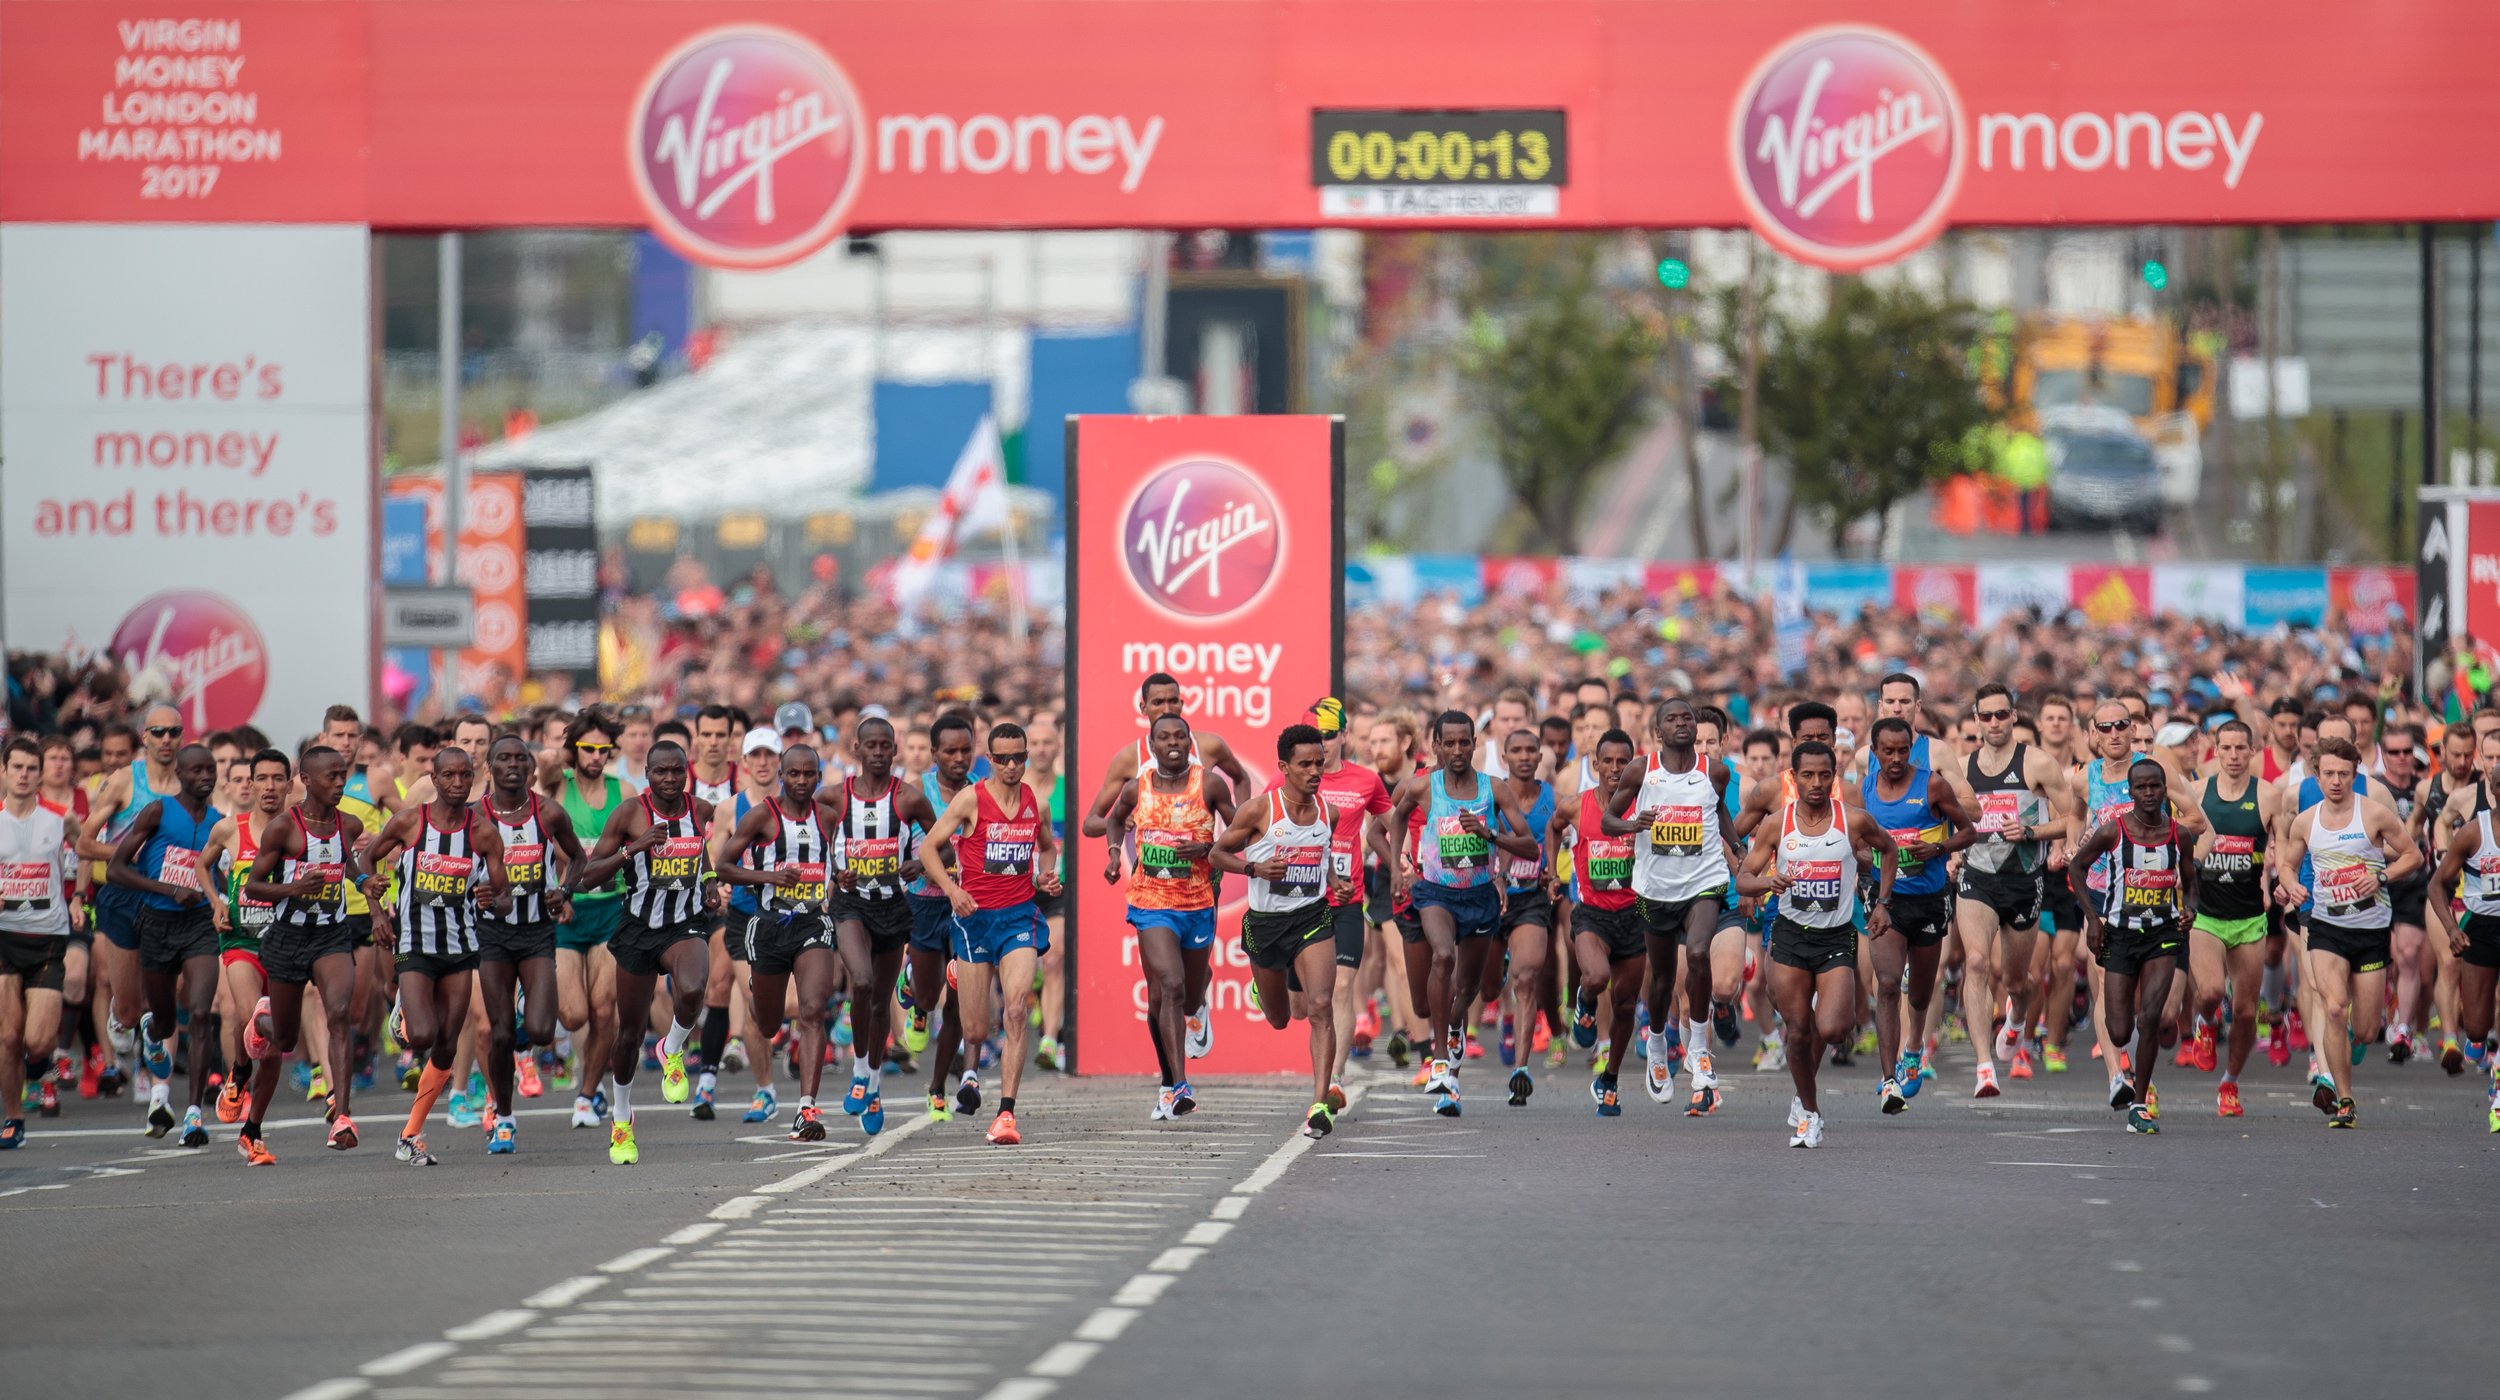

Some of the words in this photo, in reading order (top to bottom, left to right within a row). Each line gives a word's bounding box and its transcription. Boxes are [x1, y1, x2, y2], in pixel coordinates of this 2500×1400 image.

[117, 19, 241, 51] VIRGIN
[114, 55, 245, 87] MONEY
[102, 92, 258, 125] LONDON
[77, 128, 281, 162] MARATHON
[655, 57, 843, 225] Virgin
[877, 113, 1164, 192] money
[1756, 57, 1942, 222] Virgin
[1978, 111, 2264, 189] money
[1327, 129, 1552, 181] 00:00:13
[140, 165, 221, 199] 2017
[86, 353, 283, 401] There's
[93, 431, 279, 477] money
[34, 489, 136, 536] and
[155, 488, 338, 536] there's
[1137, 478, 1269, 598] Virgin
[1122, 642, 1282, 683] money
[1674, 810, 1701, 818] money
[1655, 825, 1697, 842] KIRUI
[514, 848, 541, 858] money
[675, 842, 701, 852] money
[870, 842, 896, 850] money
[1441, 837, 1488, 854] REGASSA
[1142, 846, 1191, 865] KARO
[1336, 856, 1345, 872] 5
[2205, 853, 2252, 871] DAVIES
[442, 861, 471, 872] money
[533, 864, 542, 880] 5
[652, 858, 689, 876] PACE
[692, 858, 699, 874] 1
[848, 858, 884, 876] PACE
[888, 856, 897, 873] 3
[1281, 866, 1321, 883] HIRMAY
[1812, 864, 1840, 874] money
[415, 871, 455, 893] PACE
[456, 877, 465, 894] 9
[815, 883, 825, 900] 8
[1791, 880, 1840, 898] BEKELE
[333, 883, 341, 901] 2
[2125, 887, 2161, 905] PACE
[2164, 888, 2171, 904] 4
